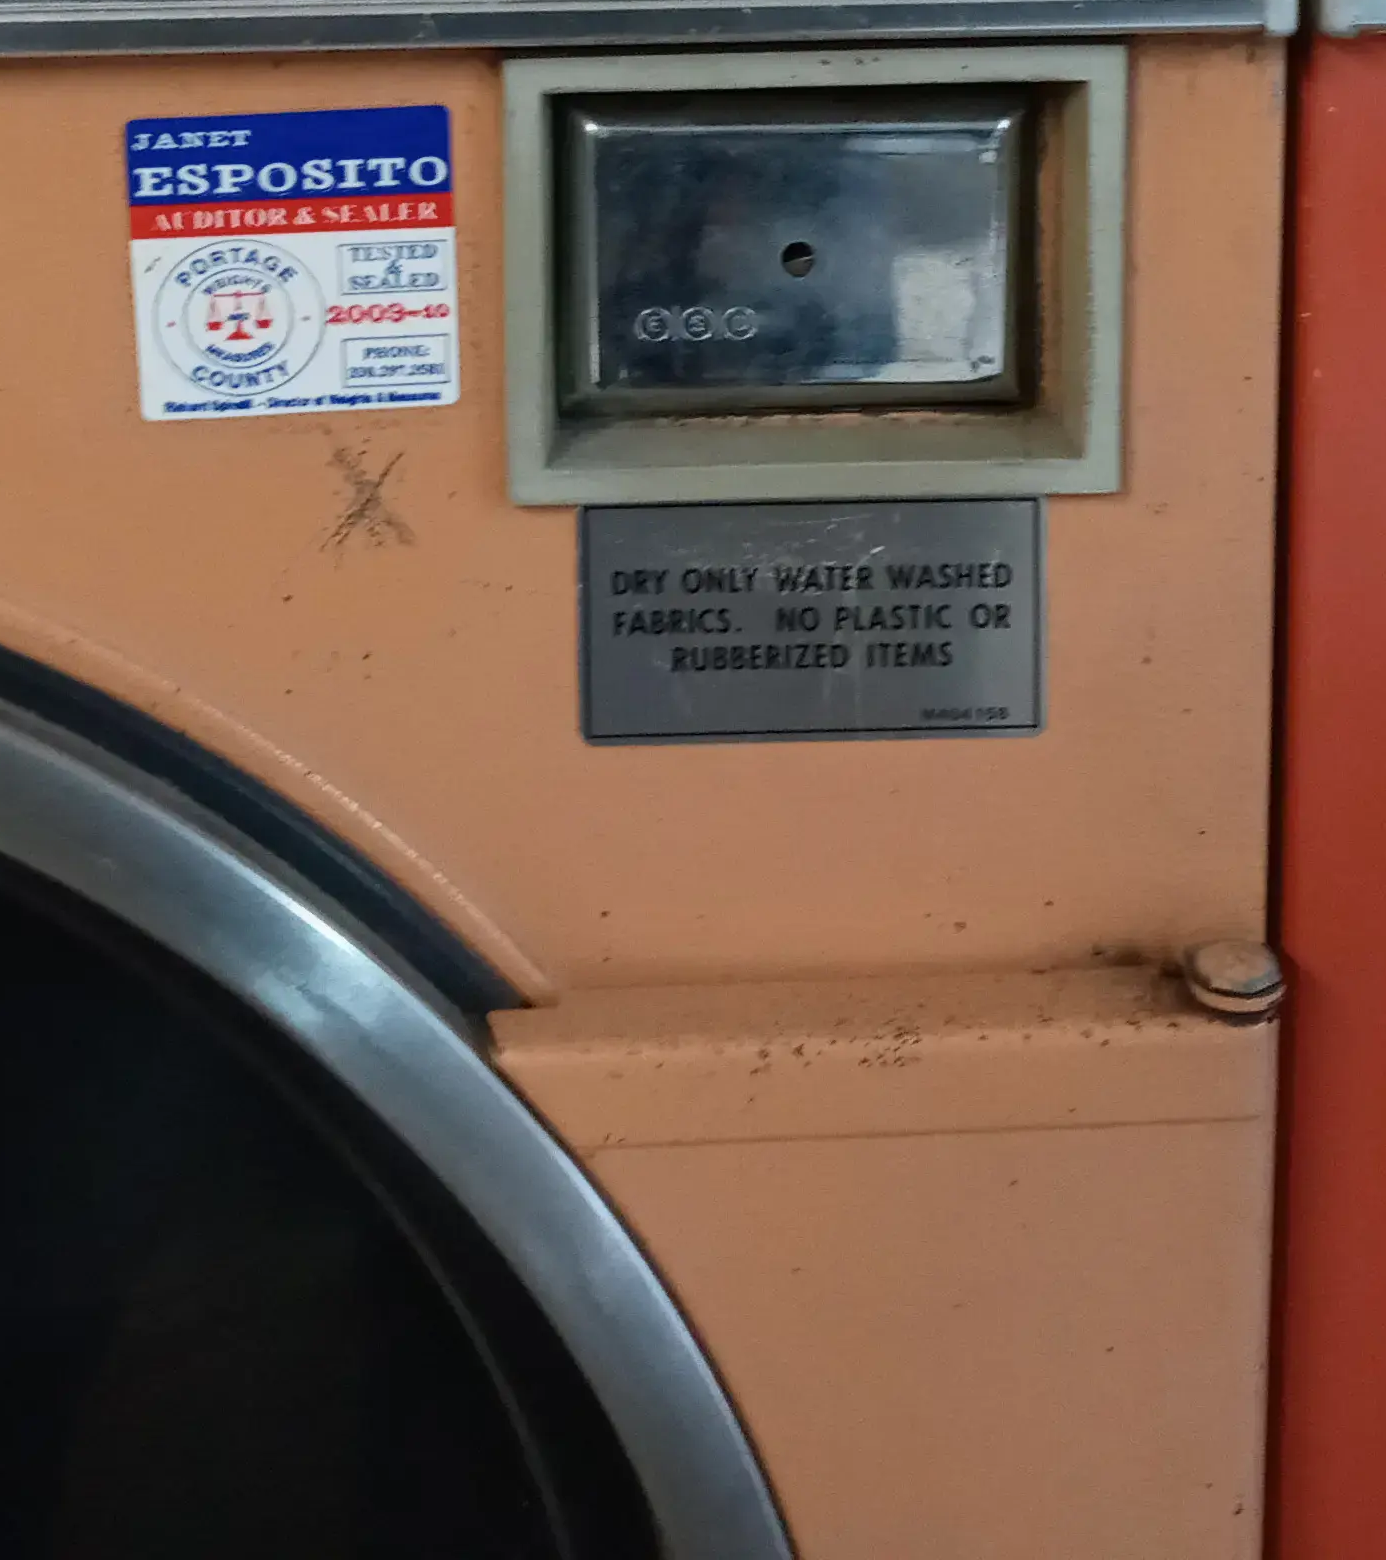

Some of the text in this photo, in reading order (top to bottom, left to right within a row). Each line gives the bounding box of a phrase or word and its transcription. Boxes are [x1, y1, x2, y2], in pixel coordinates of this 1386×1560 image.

[130, 129, 252, 151] JANET
[132, 155, 449, 198] ESPOSITO
[151, 201, 439, 233] AUDITOR & SEALER
[174, 246, 299, 288] PORTAGE
[347, 243, 439, 263] TESTED
[347, 272, 440, 291] SEALED
[190, 358, 291, 389] COUNTY
[611, 562, 1013, 595] DRY ONLY WATER WASHED
[613, 601, 1012, 635] FABRICS. NO PLASTIC OR
[670, 641, 954, 672] RUBBERIZED ITEMS
